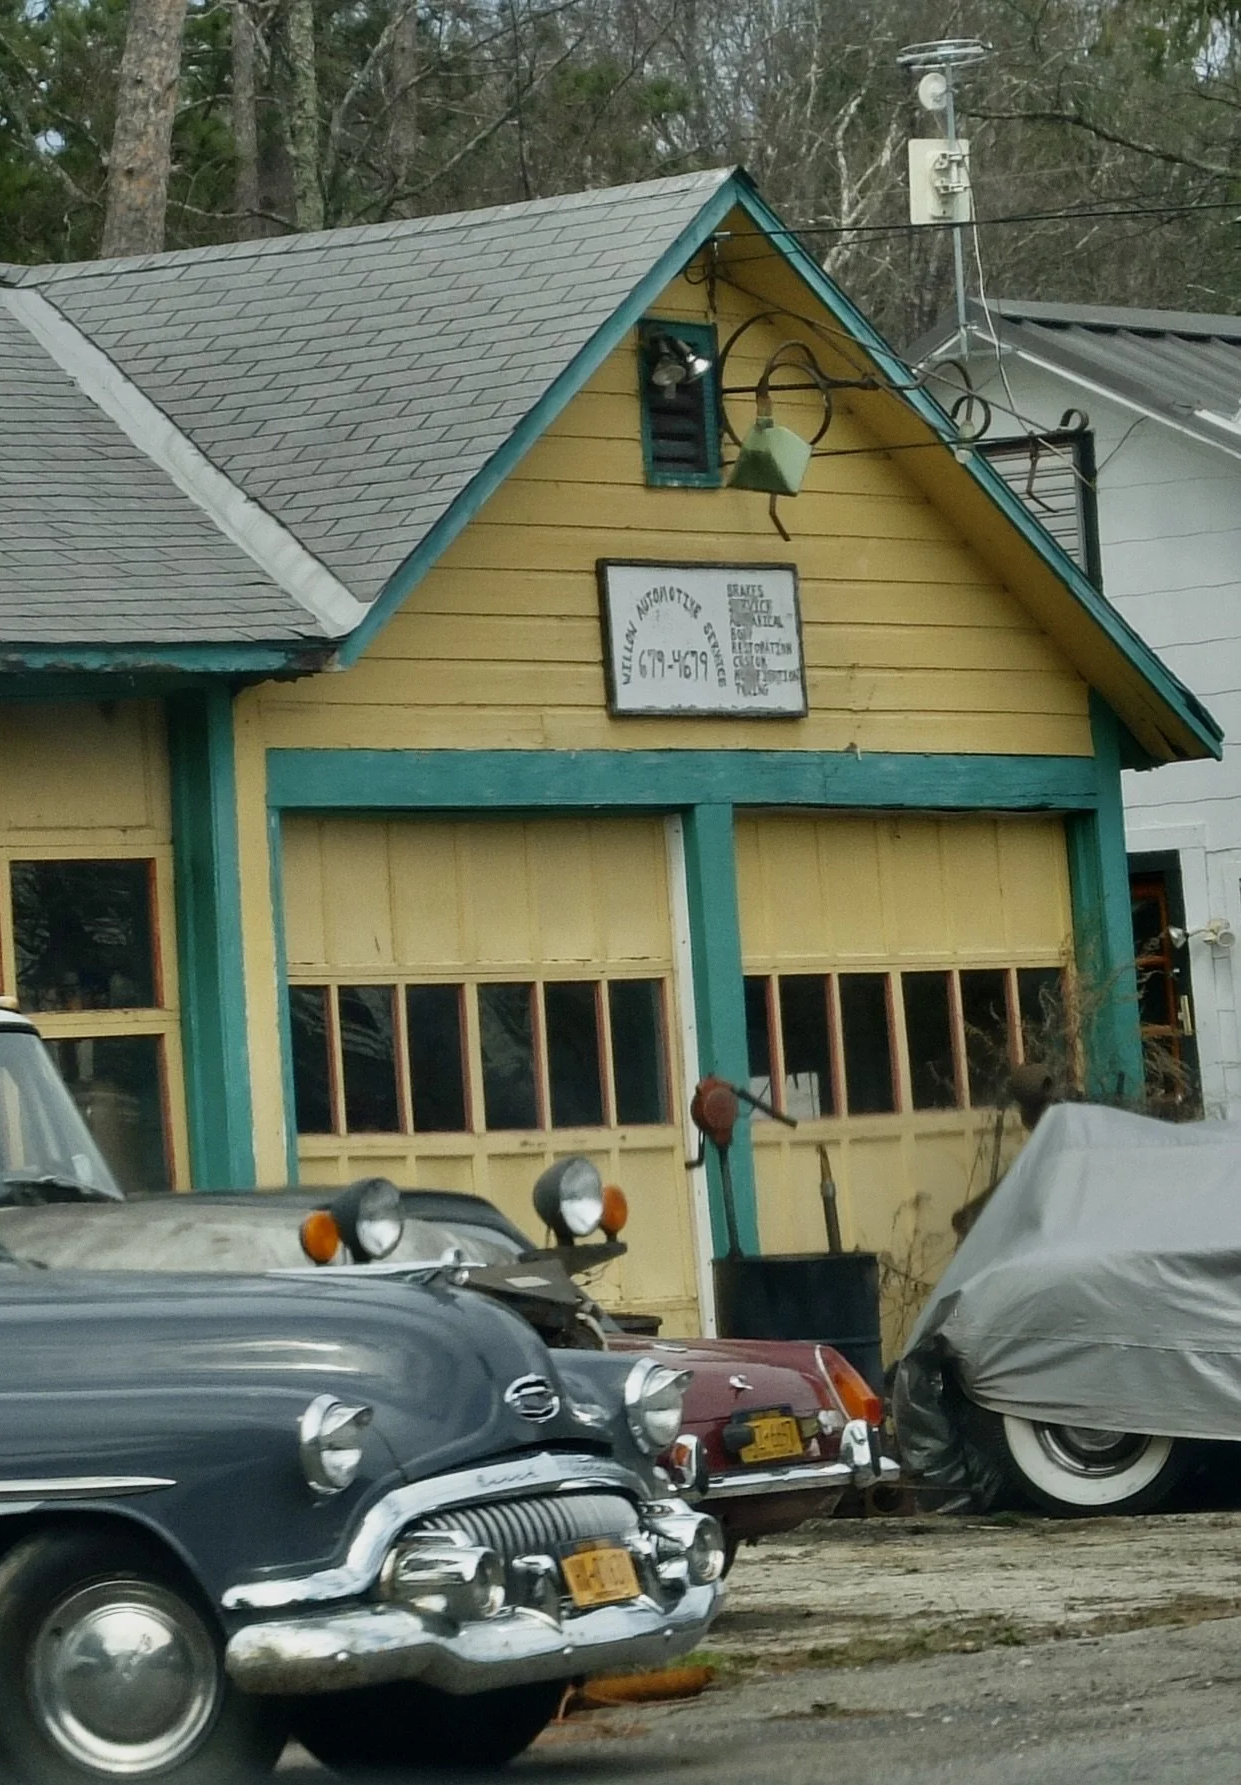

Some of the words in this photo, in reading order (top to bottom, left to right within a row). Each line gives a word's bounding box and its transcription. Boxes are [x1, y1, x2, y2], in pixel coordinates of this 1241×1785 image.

[726, 583, 764, 598] BRAKES
[621, 619, 638, 686] WILLOW
[636, 585, 702, 621] AUTOMOTIVE
[638, 648, 709, 682] 679-4679
